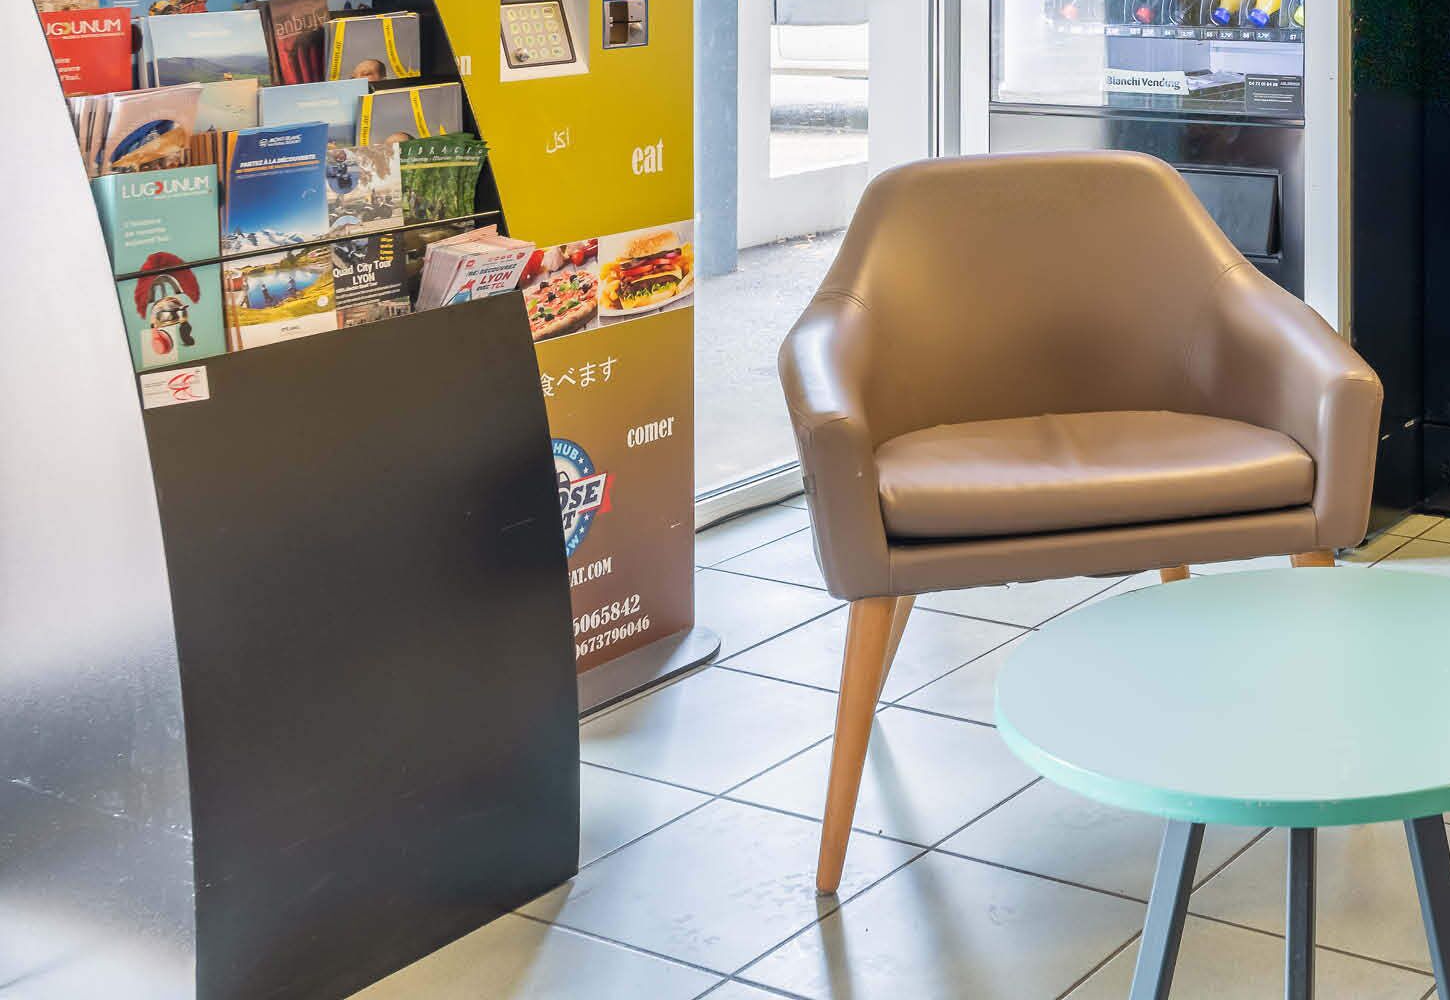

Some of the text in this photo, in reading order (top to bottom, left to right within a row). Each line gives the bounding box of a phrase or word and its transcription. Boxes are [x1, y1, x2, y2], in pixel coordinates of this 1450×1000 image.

[1106, 75, 1140, 86] Bianchi
[631, 139, 664, 176] eat
[333, 259, 392, 278] Quad City Tour
[352, 273, 375, 286] LYON
[480, 271, 512, 285] LYON
[491, 281, 505, 290] TCL
[626, 416, 675, 448] comer
[553, 442, 579, 460] HUB
[568, 557, 613, 587] AT.COM
